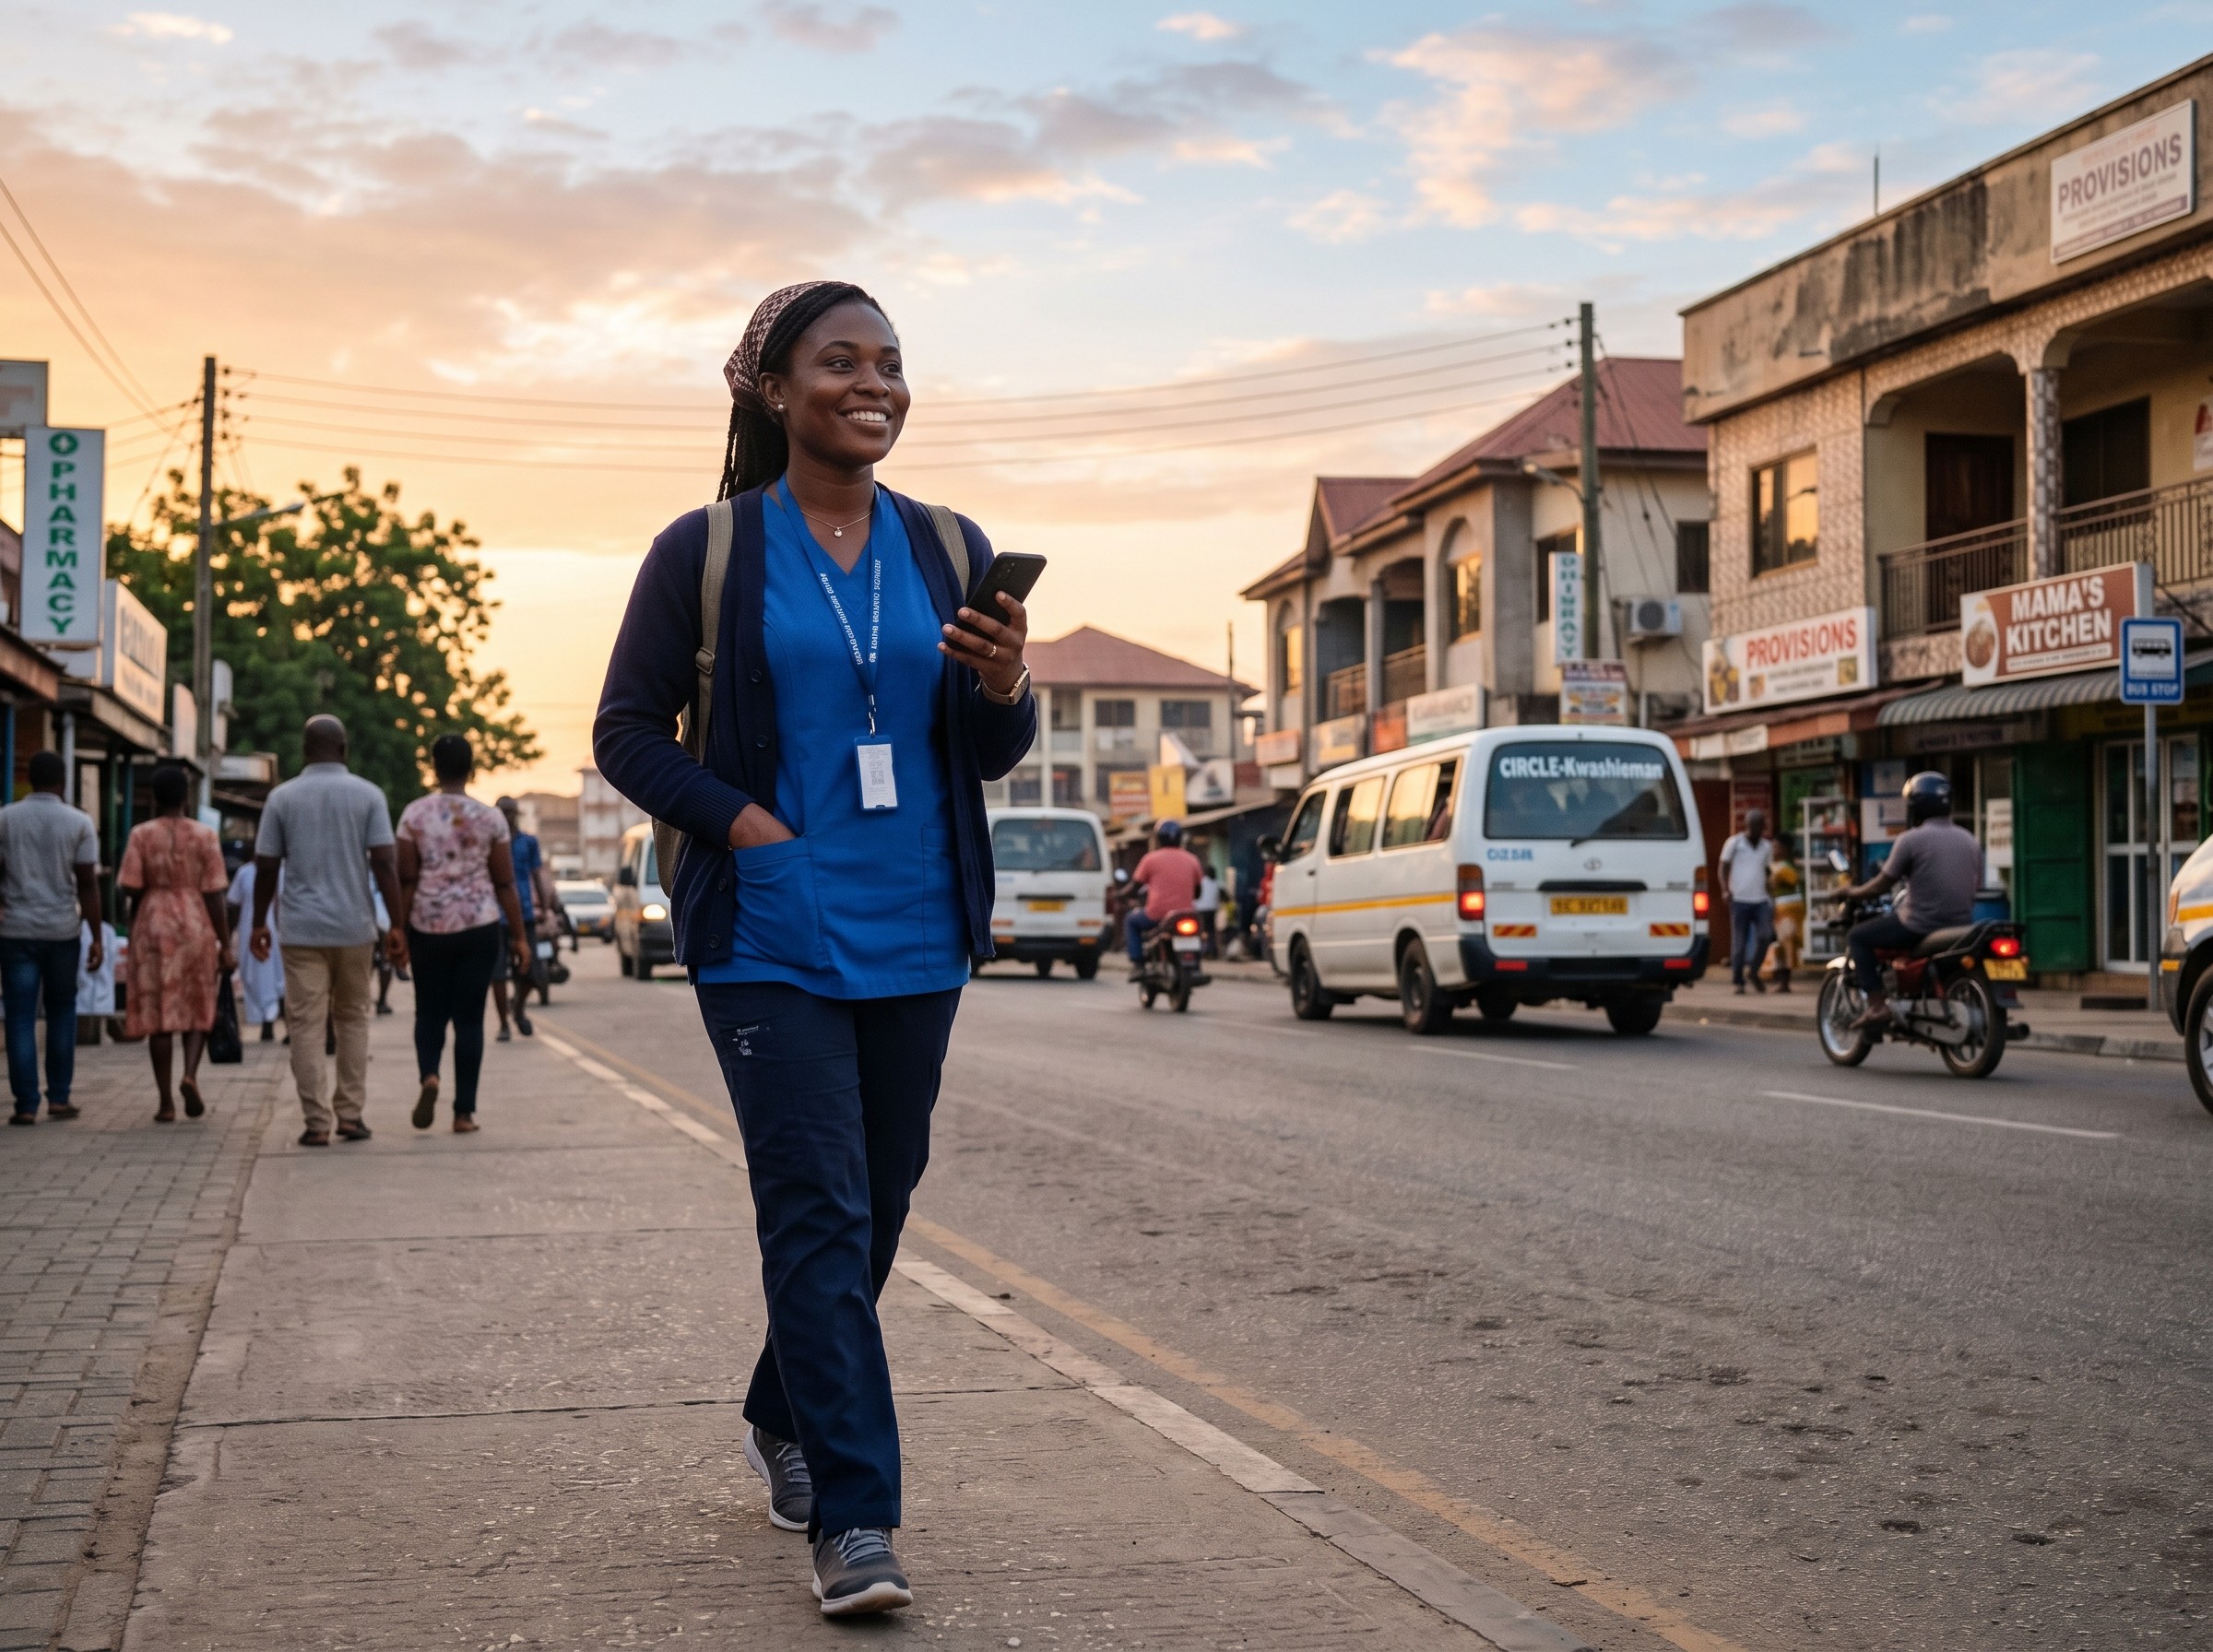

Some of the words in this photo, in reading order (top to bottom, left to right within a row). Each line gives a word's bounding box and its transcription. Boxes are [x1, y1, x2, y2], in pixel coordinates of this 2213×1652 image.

[2057, 133, 2182, 213] PROVISIONS
[46, 462, 77, 636] PHARMACY
[2010, 575, 2105, 623] MAMA'S
[1746, 618, 1857, 669] PROVISIONS
[2005, 608, 2112, 655] KITCHEN
[2126, 683, 2148, 697] BUS
[2151, 683, 2179, 697] STOP
